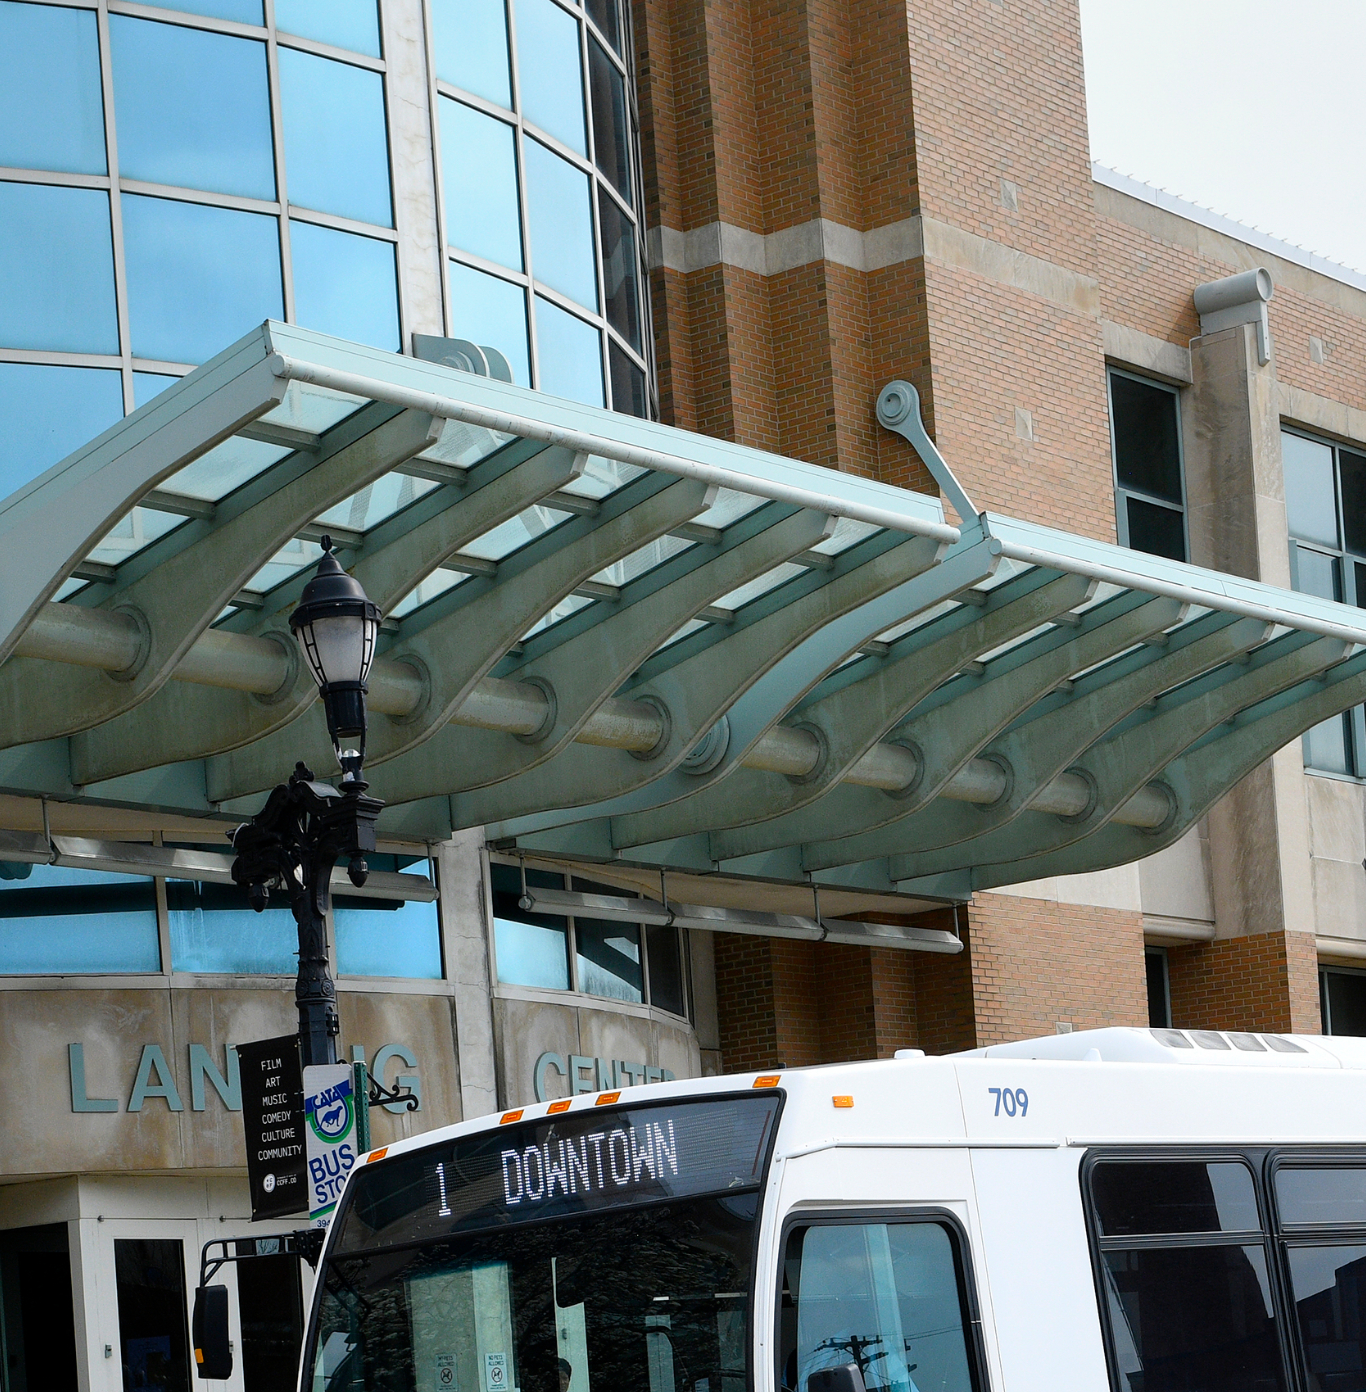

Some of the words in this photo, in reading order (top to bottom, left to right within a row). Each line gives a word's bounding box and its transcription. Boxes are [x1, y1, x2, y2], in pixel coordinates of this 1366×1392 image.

[261, 1058, 282, 1071] FILM
[68, 1043, 422, 1114] LANG
[265, 1076, 281, 1088] ART
[262, 1093, 288, 1106] MUSIC
[312, 1086, 341, 1111] CATA
[988, 1087, 1029, 1117] 709
[262, 1110, 292, 1125] COMEDY
[261, 1127, 295, 1143] CULTURE
[257, 1144, 302, 1161] COMMUNITY
[308, 1144, 355, 1184] BUS
[435, 1162, 451, 1217] 1
[501, 1120, 678, 1205] DOWNTOWN
[315, 1172, 351, 1203] STO
